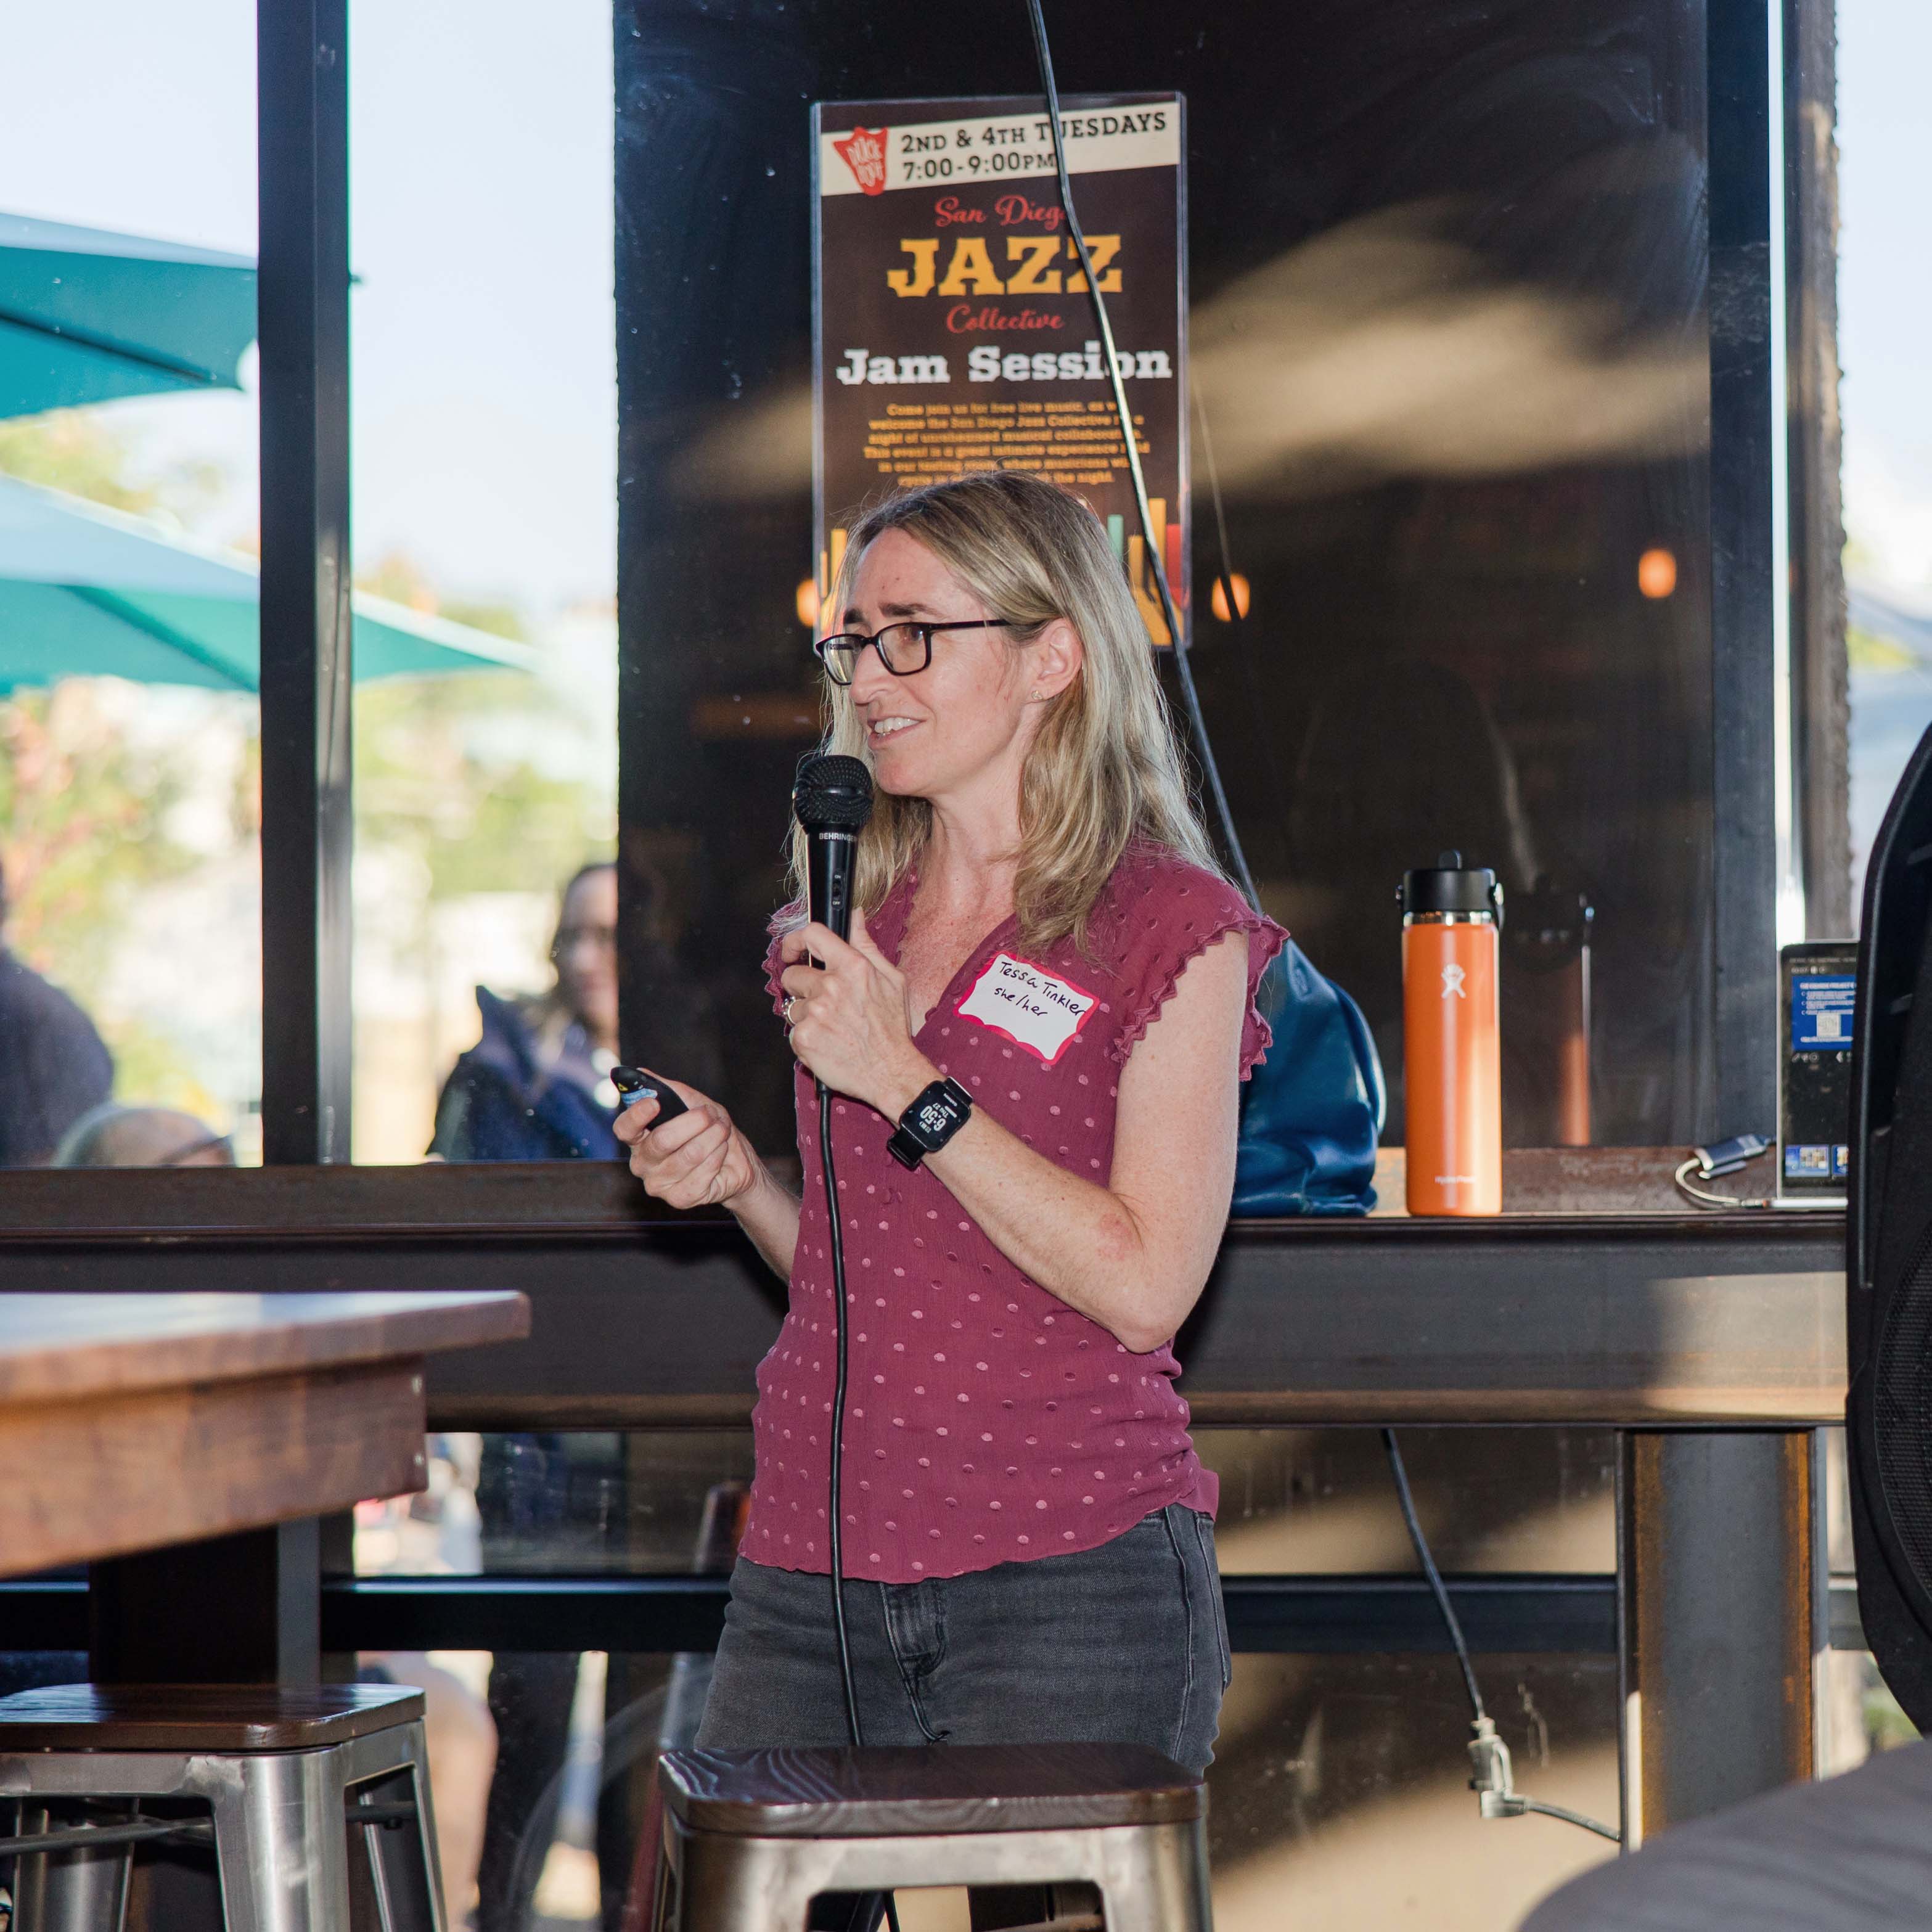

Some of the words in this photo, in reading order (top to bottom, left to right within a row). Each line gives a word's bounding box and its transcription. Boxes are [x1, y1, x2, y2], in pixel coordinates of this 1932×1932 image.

[902, 134, 947, 153] 2ND
[956, 129, 972, 147] &
[982, 127, 1025, 146] 4TH
[903, 153, 1057, 181] 7:00-9:00PM
[935, 196, 988, 227] San
[994, 194, 1065, 231] Dieg
[886, 235, 1123, 298] JAZZ
[946, 303, 1065, 334] Collective
[835, 348, 951, 385] Jam
[968, 340, 1173, 382] Session
[994, 987, 1049, 1017] she/her
[999, 961, 1038, 988] Tessa
[1041, 981, 1086, 1016] Tinkler
[920, 1105, 947, 1131] 6:50
